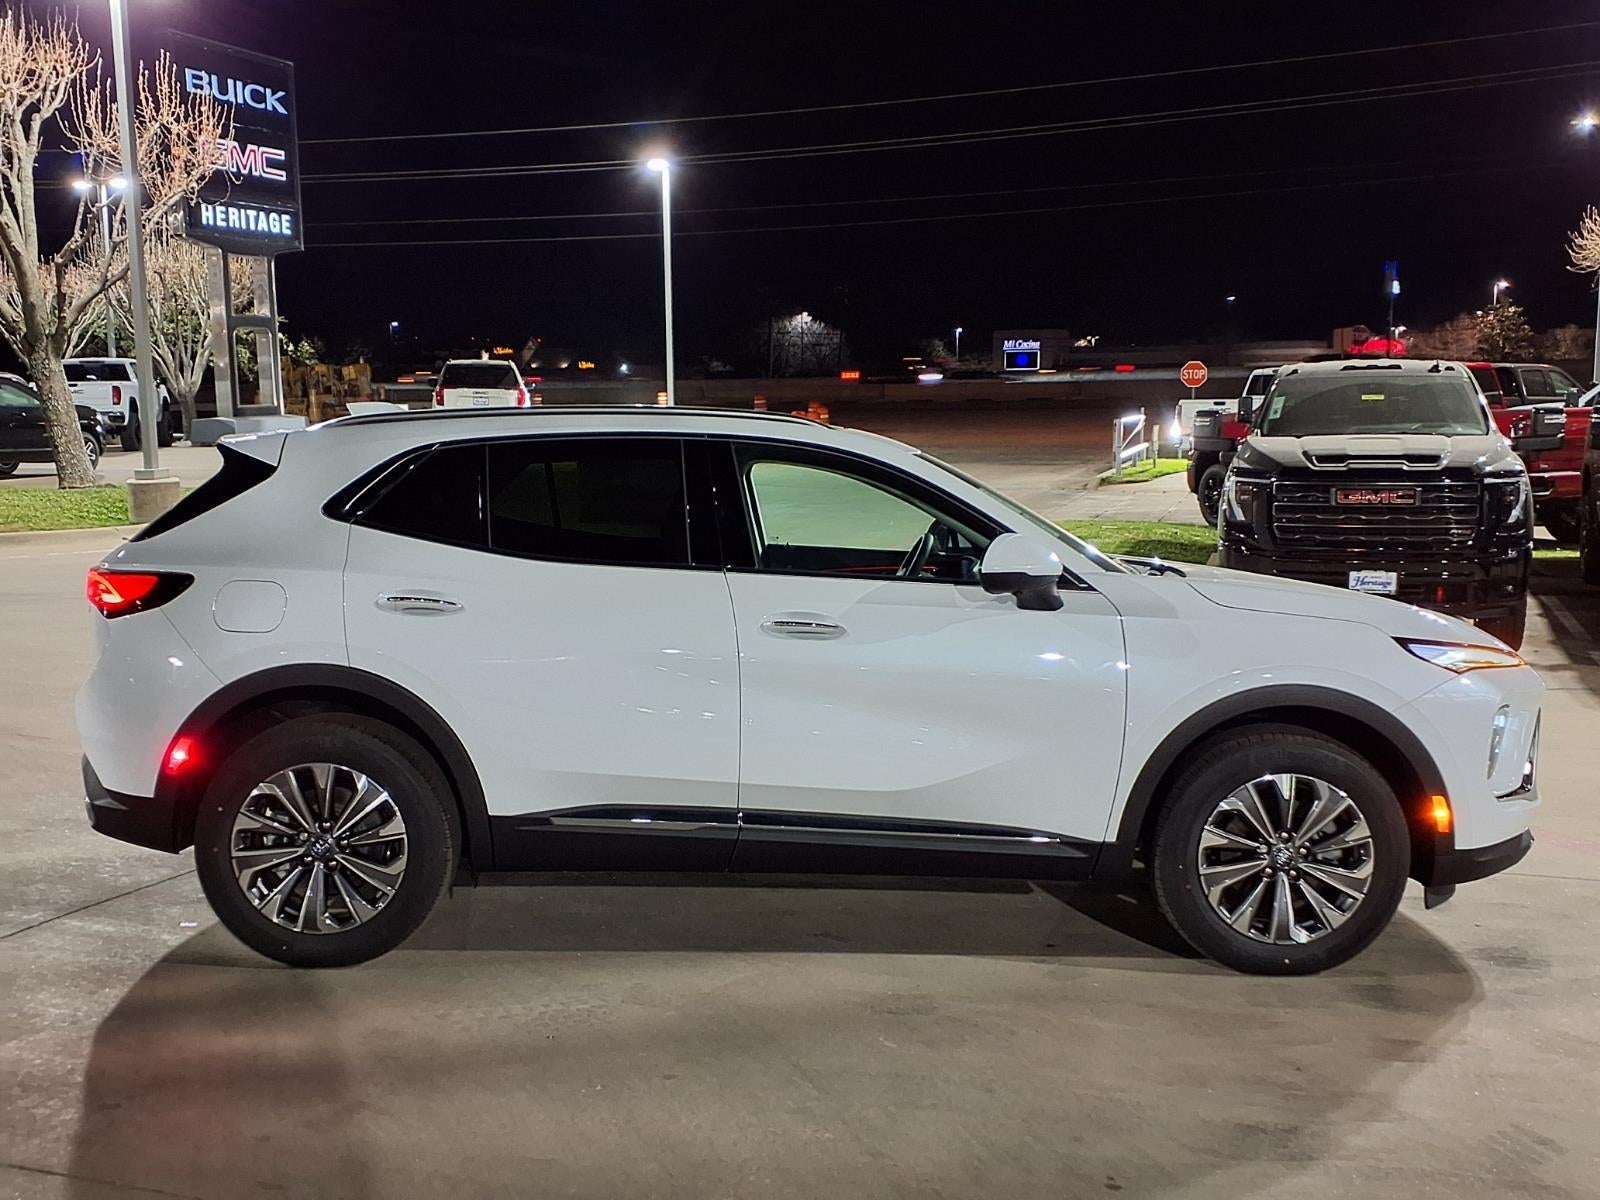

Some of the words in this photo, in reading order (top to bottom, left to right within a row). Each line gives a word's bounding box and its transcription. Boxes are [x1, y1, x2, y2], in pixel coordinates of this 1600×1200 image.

[184, 67, 288, 115] BUICK
[200, 203, 292, 235] HERITAGE
[1182, 369, 1205, 379] STOP
[1336, 489, 1415, 504] GMC
